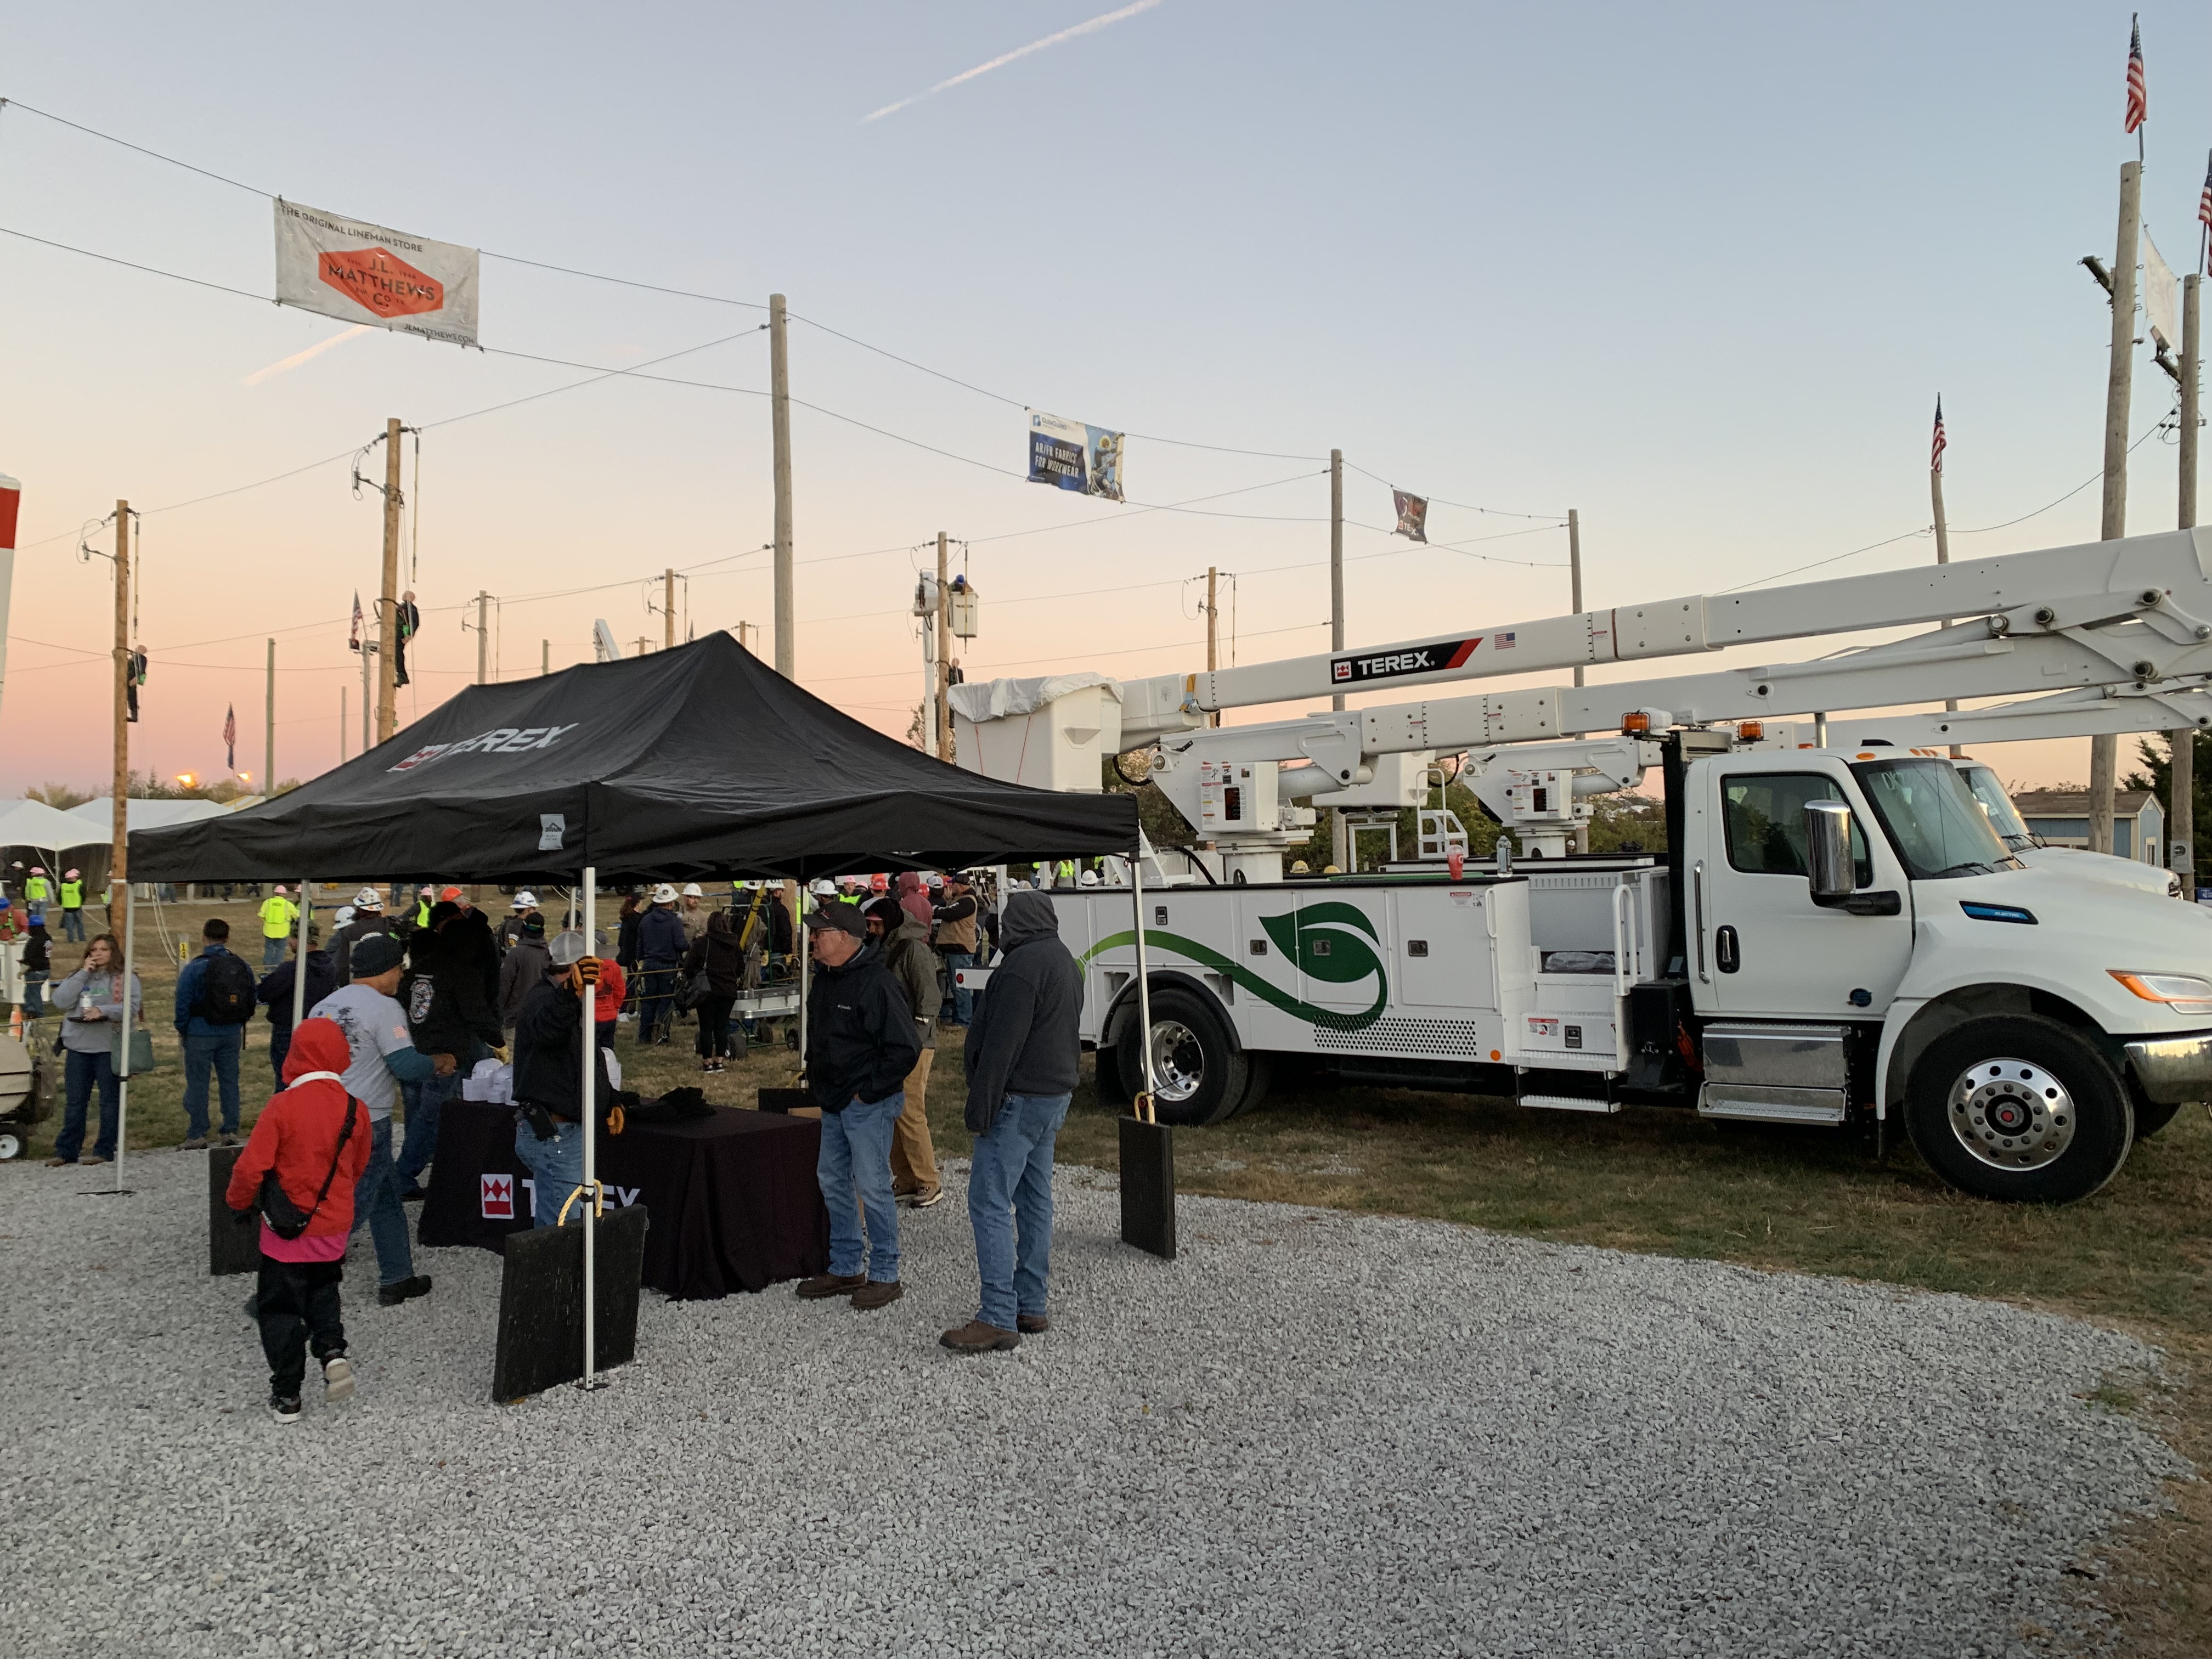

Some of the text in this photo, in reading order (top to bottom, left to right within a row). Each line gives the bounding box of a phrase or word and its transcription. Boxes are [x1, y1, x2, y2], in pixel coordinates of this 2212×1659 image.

[281, 204, 422, 252] THE ORIGINAL LINEMAN STORE
[329, 263, 435, 301] MATTHEWS
[403, 323, 474, 344] JLMATTHEWS.COM
[1035, 441, 1078, 464] AR/FR FABRICS
[1035, 455, 1079, 478] FOR WORKWEAR
[1357, 651, 1431, 675] TEREX
